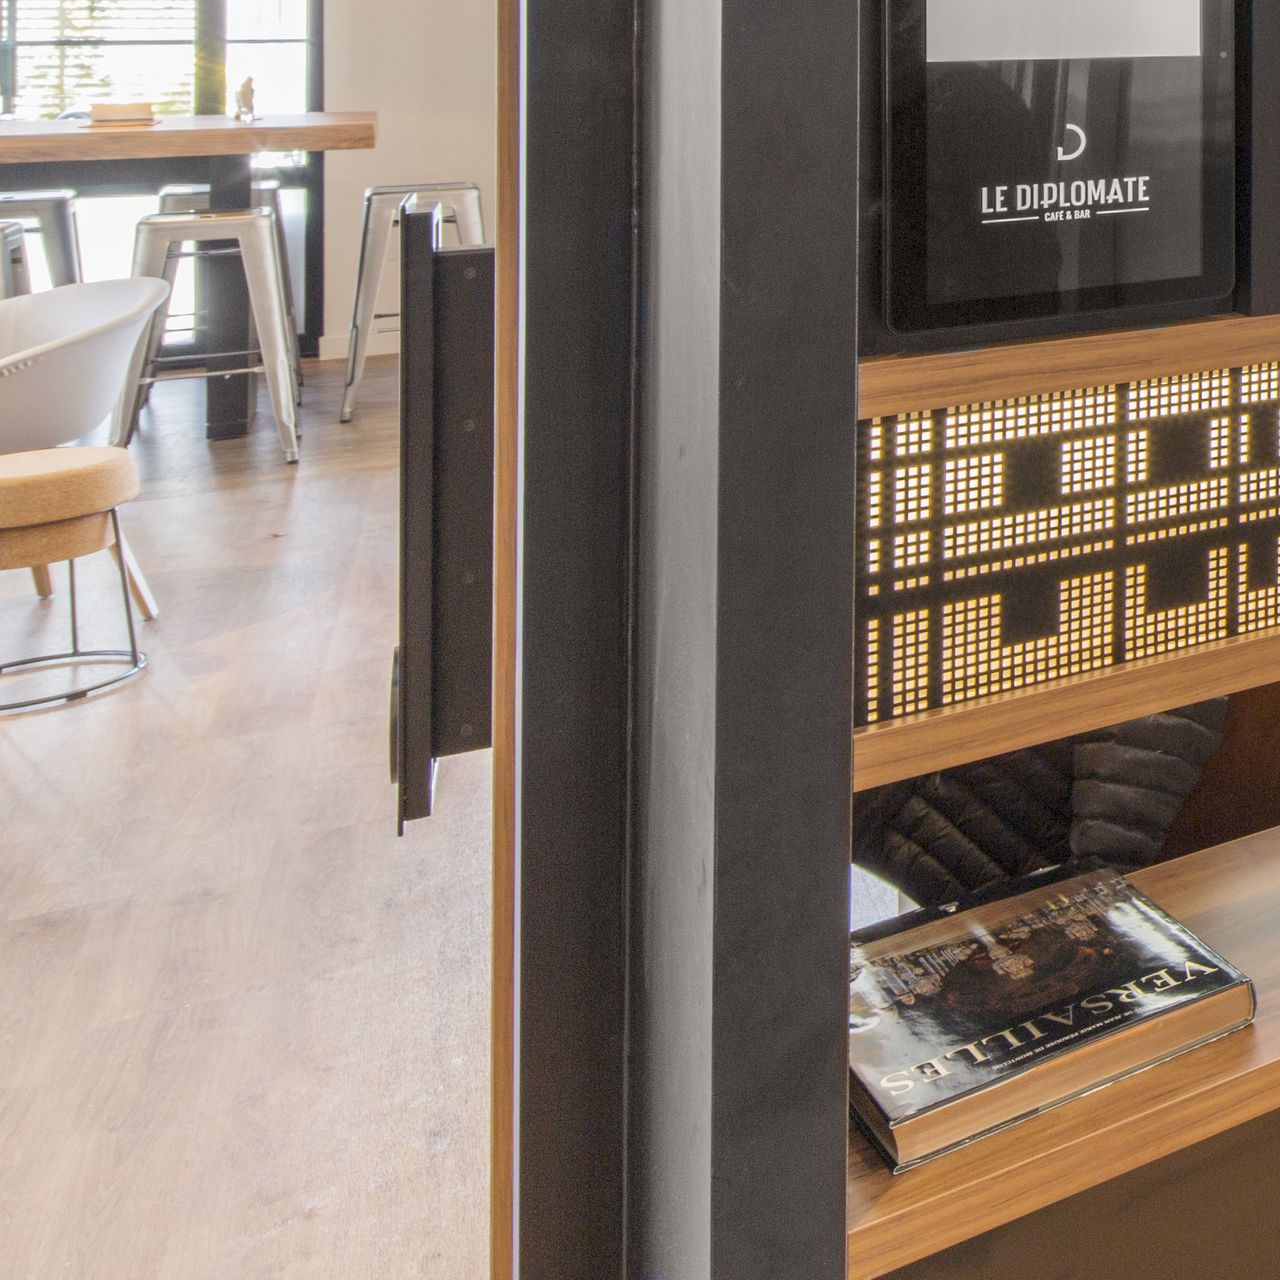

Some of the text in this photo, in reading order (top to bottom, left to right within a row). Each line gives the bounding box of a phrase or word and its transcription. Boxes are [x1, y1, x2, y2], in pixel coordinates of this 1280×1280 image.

[981, 176, 1150, 214] LE DIPLOMATE
[1044, 209, 1091, 222] CAFÉ & BAR
[879, 960, 1219, 1096] VERSAILLES
[1080, 1022, 1104, 1034] MARIE
